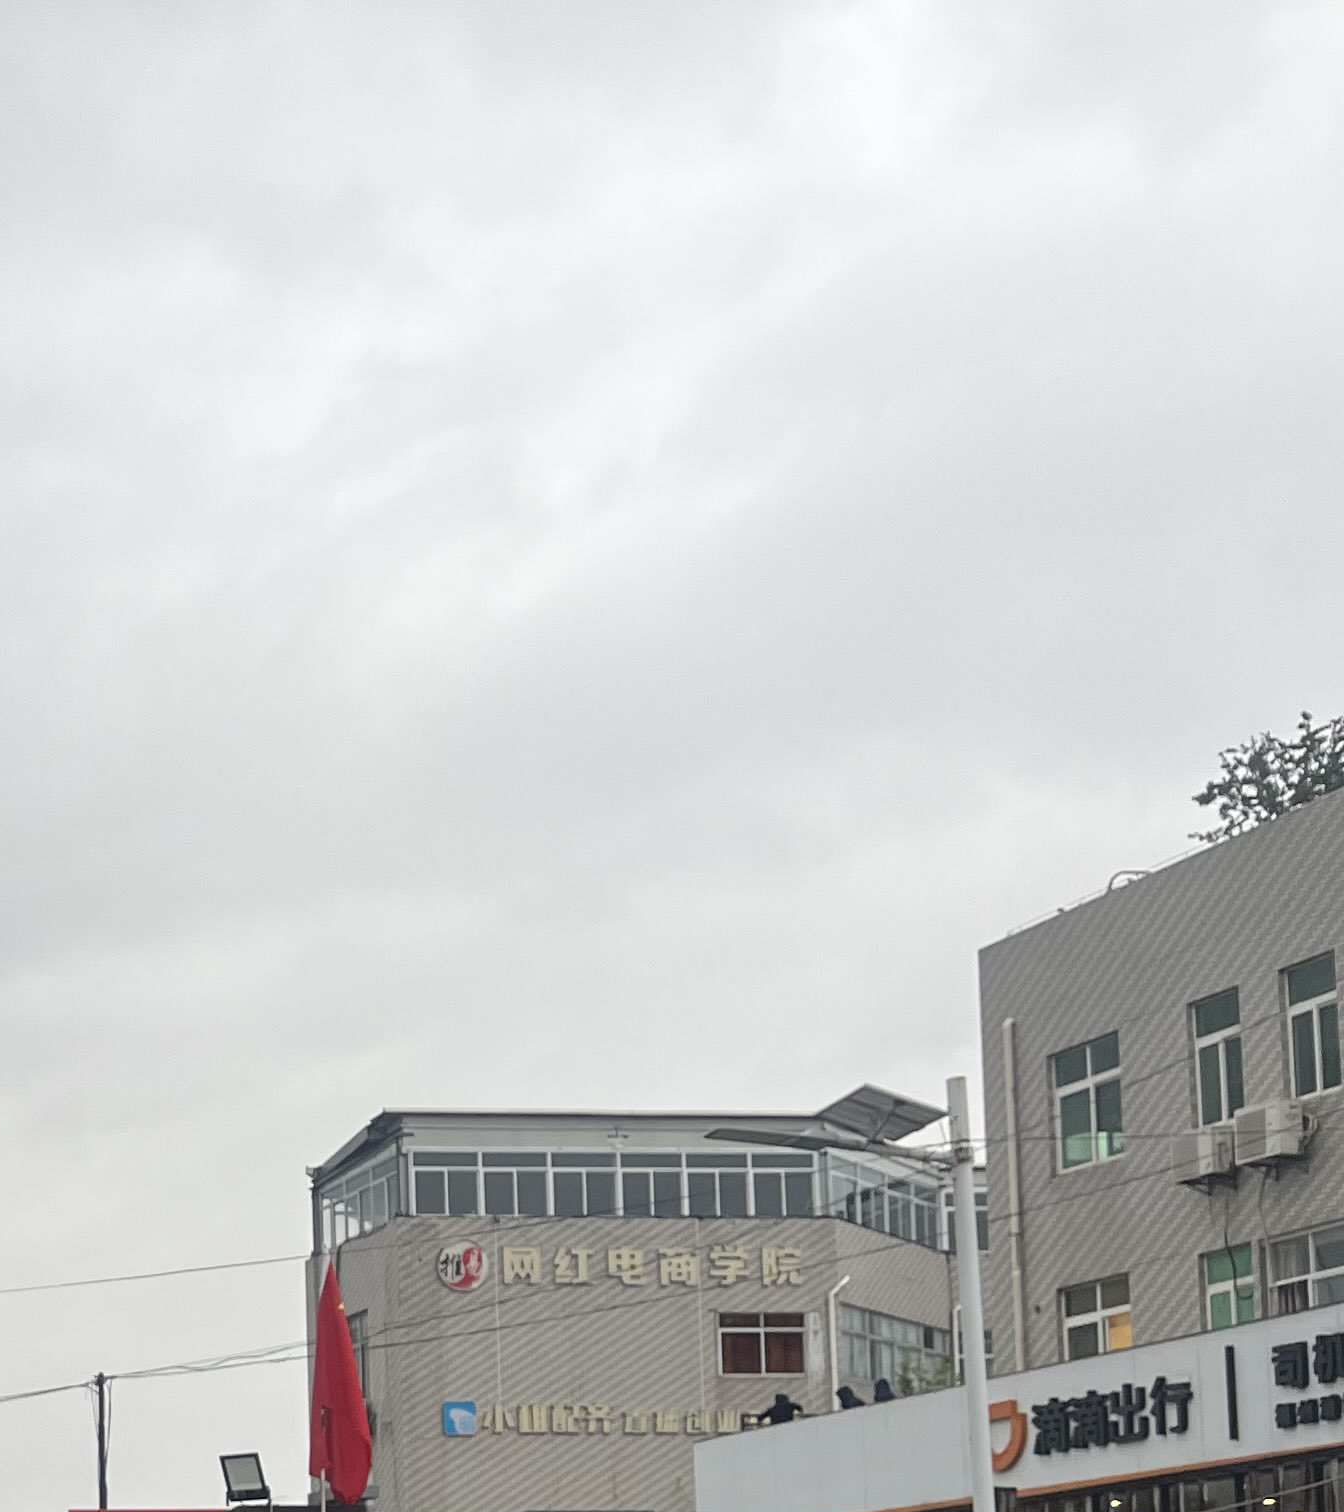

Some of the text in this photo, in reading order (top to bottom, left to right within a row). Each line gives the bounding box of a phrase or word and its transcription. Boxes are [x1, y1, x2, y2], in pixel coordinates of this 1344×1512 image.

[503, 1244, 803, 1287] 网红电商学院
[1032, 1376, 1194, 1455] 滴滴出行
